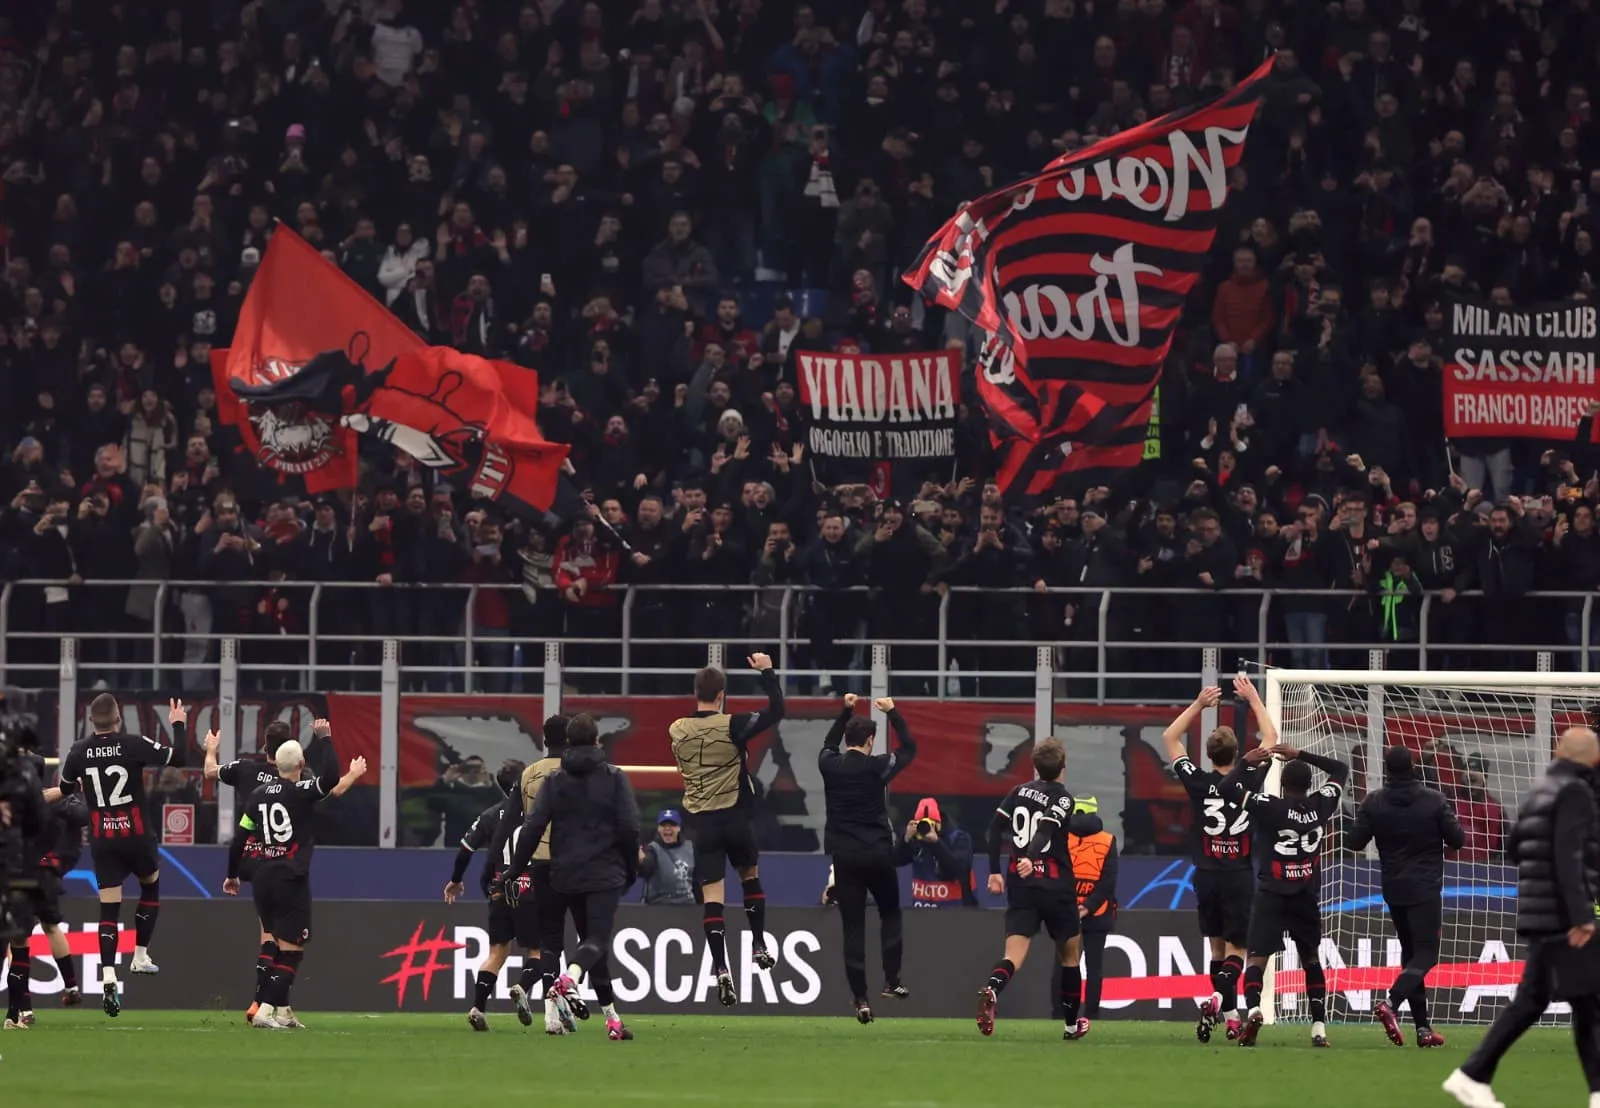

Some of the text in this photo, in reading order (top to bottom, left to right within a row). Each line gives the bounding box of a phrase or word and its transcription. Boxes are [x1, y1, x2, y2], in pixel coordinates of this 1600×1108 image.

[1453, 303, 1597, 338] MILAN CLUB
[1453, 348, 1596, 384] SASSARI
[801, 355, 955, 422] VIADANA
[1454, 393, 1595, 428] FRANCO BARES
[874, 430, 883, 457] E
[885, 428, 955, 457] TRADIZIONE
[85, 764, 133, 807] 12
[103, 821, 131, 830] MILAN
[258, 802, 293, 844] 19
[1274, 825, 1323, 856] 20
[1211, 844, 1239, 853] MILAN
[378, 919, 821, 1008] #RESCARS
